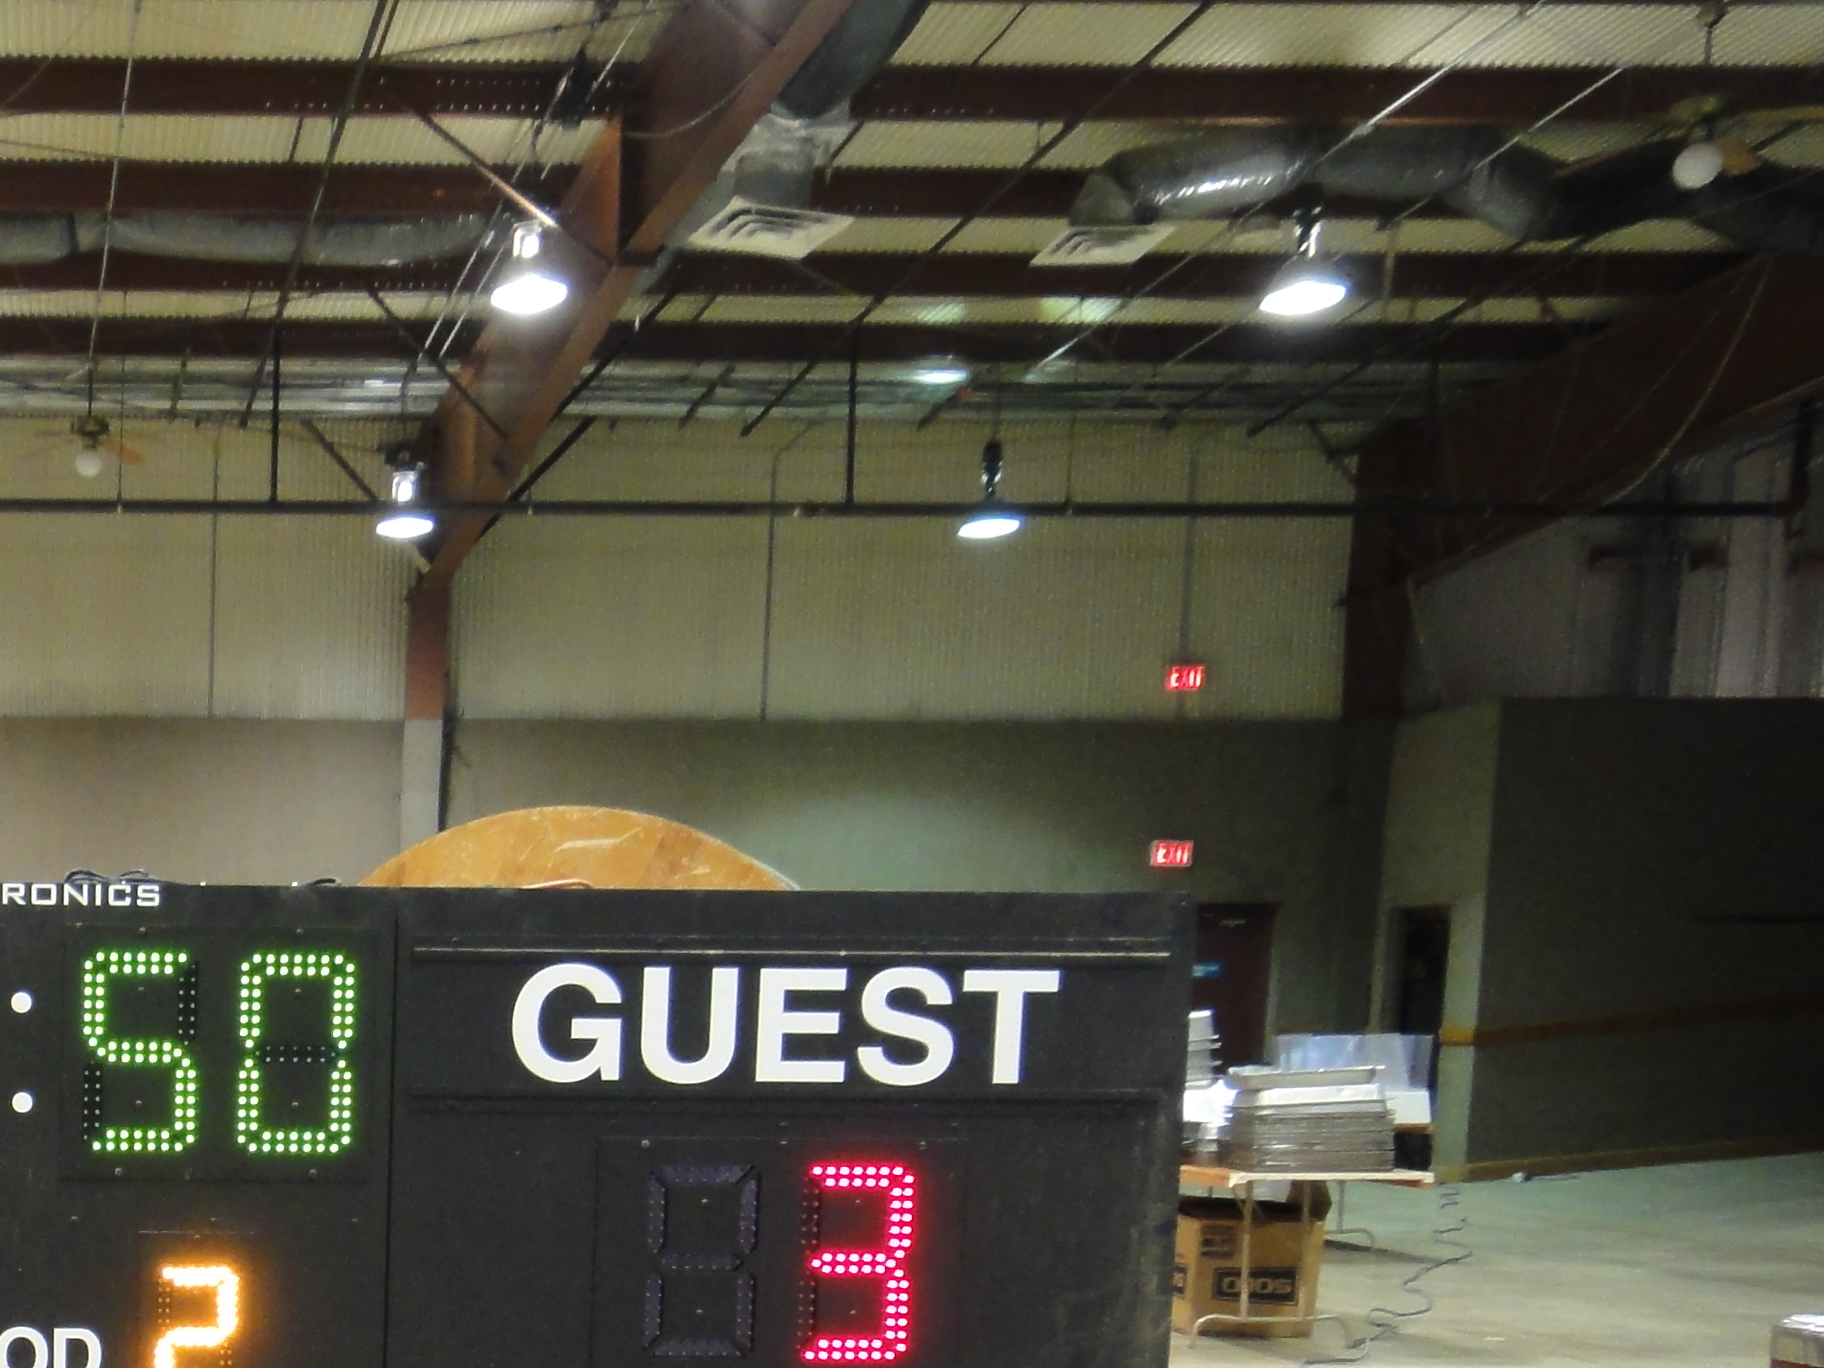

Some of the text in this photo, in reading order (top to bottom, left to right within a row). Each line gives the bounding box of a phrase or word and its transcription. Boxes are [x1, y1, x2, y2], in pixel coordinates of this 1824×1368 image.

[1169, 665, 1204, 688] EXIT
[1156, 842, 1190, 864] EXIT
[511, 962, 1061, 1087] GUEST
[800, 1161, 917, 1364] 3
